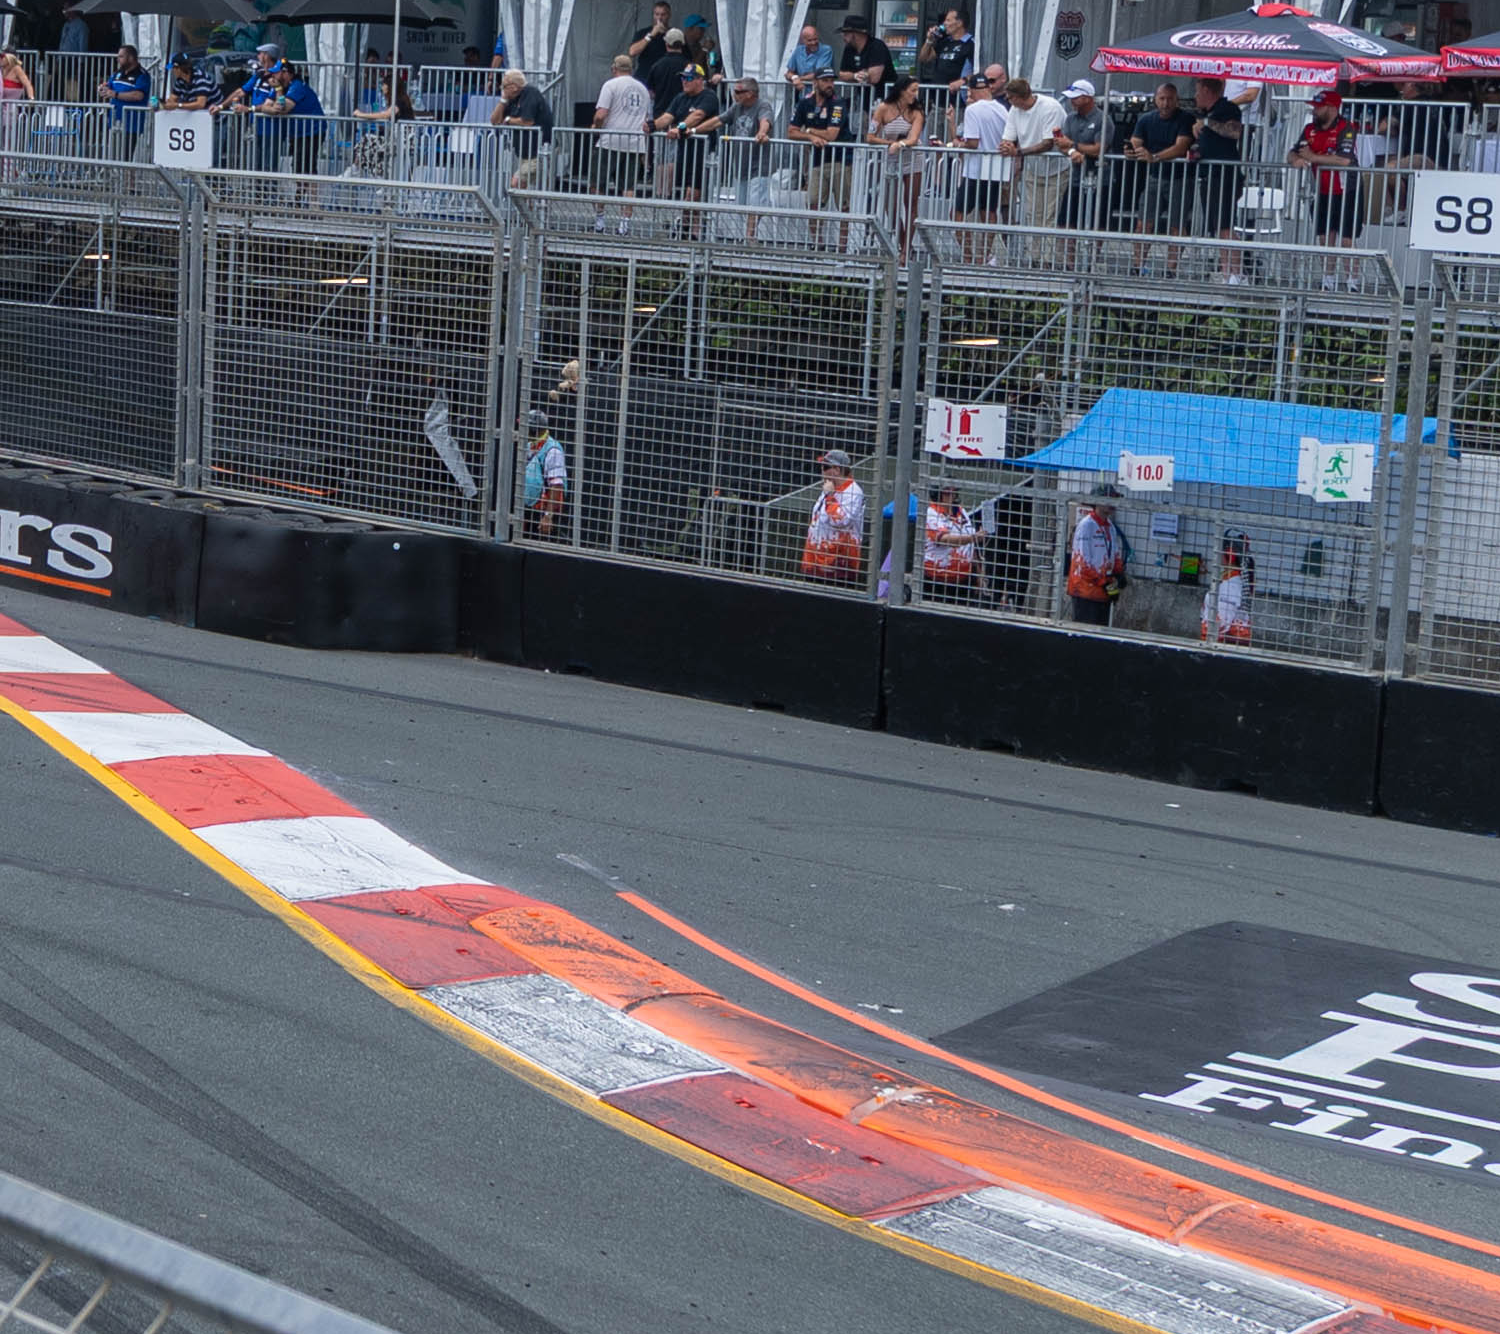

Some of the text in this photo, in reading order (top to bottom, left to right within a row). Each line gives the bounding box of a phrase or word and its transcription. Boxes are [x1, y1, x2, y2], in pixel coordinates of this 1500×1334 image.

[1191, 34, 1291, 47] DYNAMIC
[169, 128, 195, 152] S8
[1435, 196, 1493, 235] S8
[1136, 465, 1163, 481] 10.0
